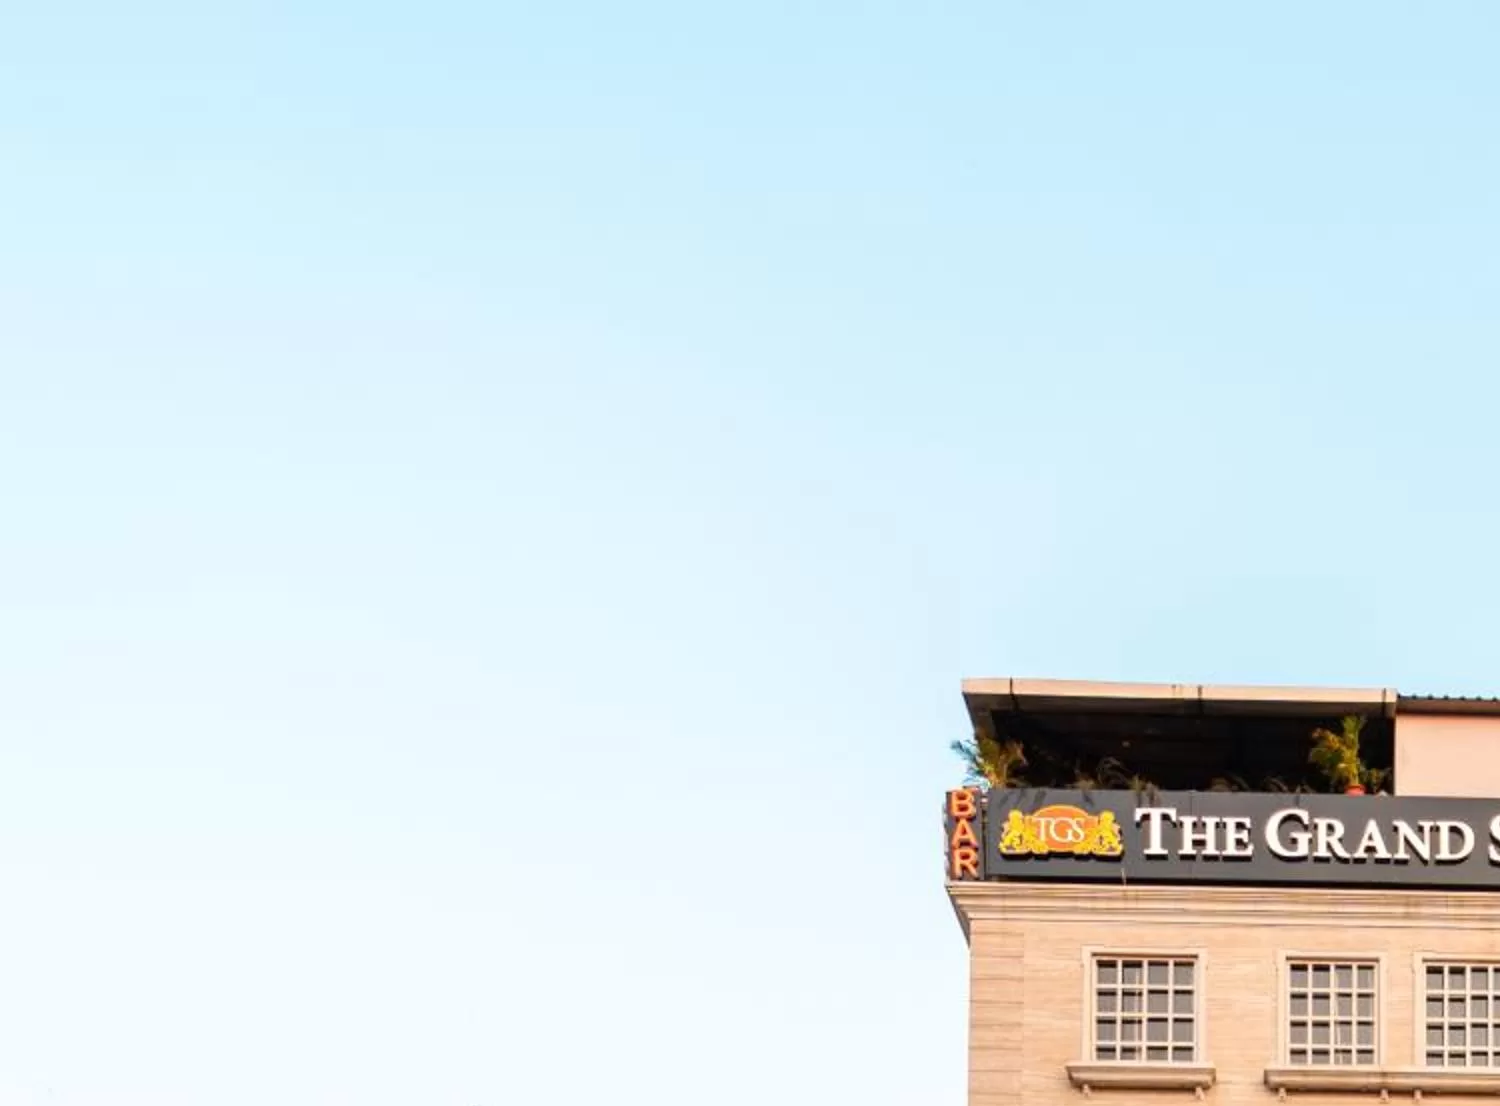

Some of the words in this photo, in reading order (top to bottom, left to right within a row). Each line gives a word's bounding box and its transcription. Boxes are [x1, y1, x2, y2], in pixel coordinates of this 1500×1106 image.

[951, 789, 979, 879] BAR
[1036, 817, 1085, 843] TGS
[1134, 806, 1254, 858] THE
[1264, 808, 1474, 861] GRAND
